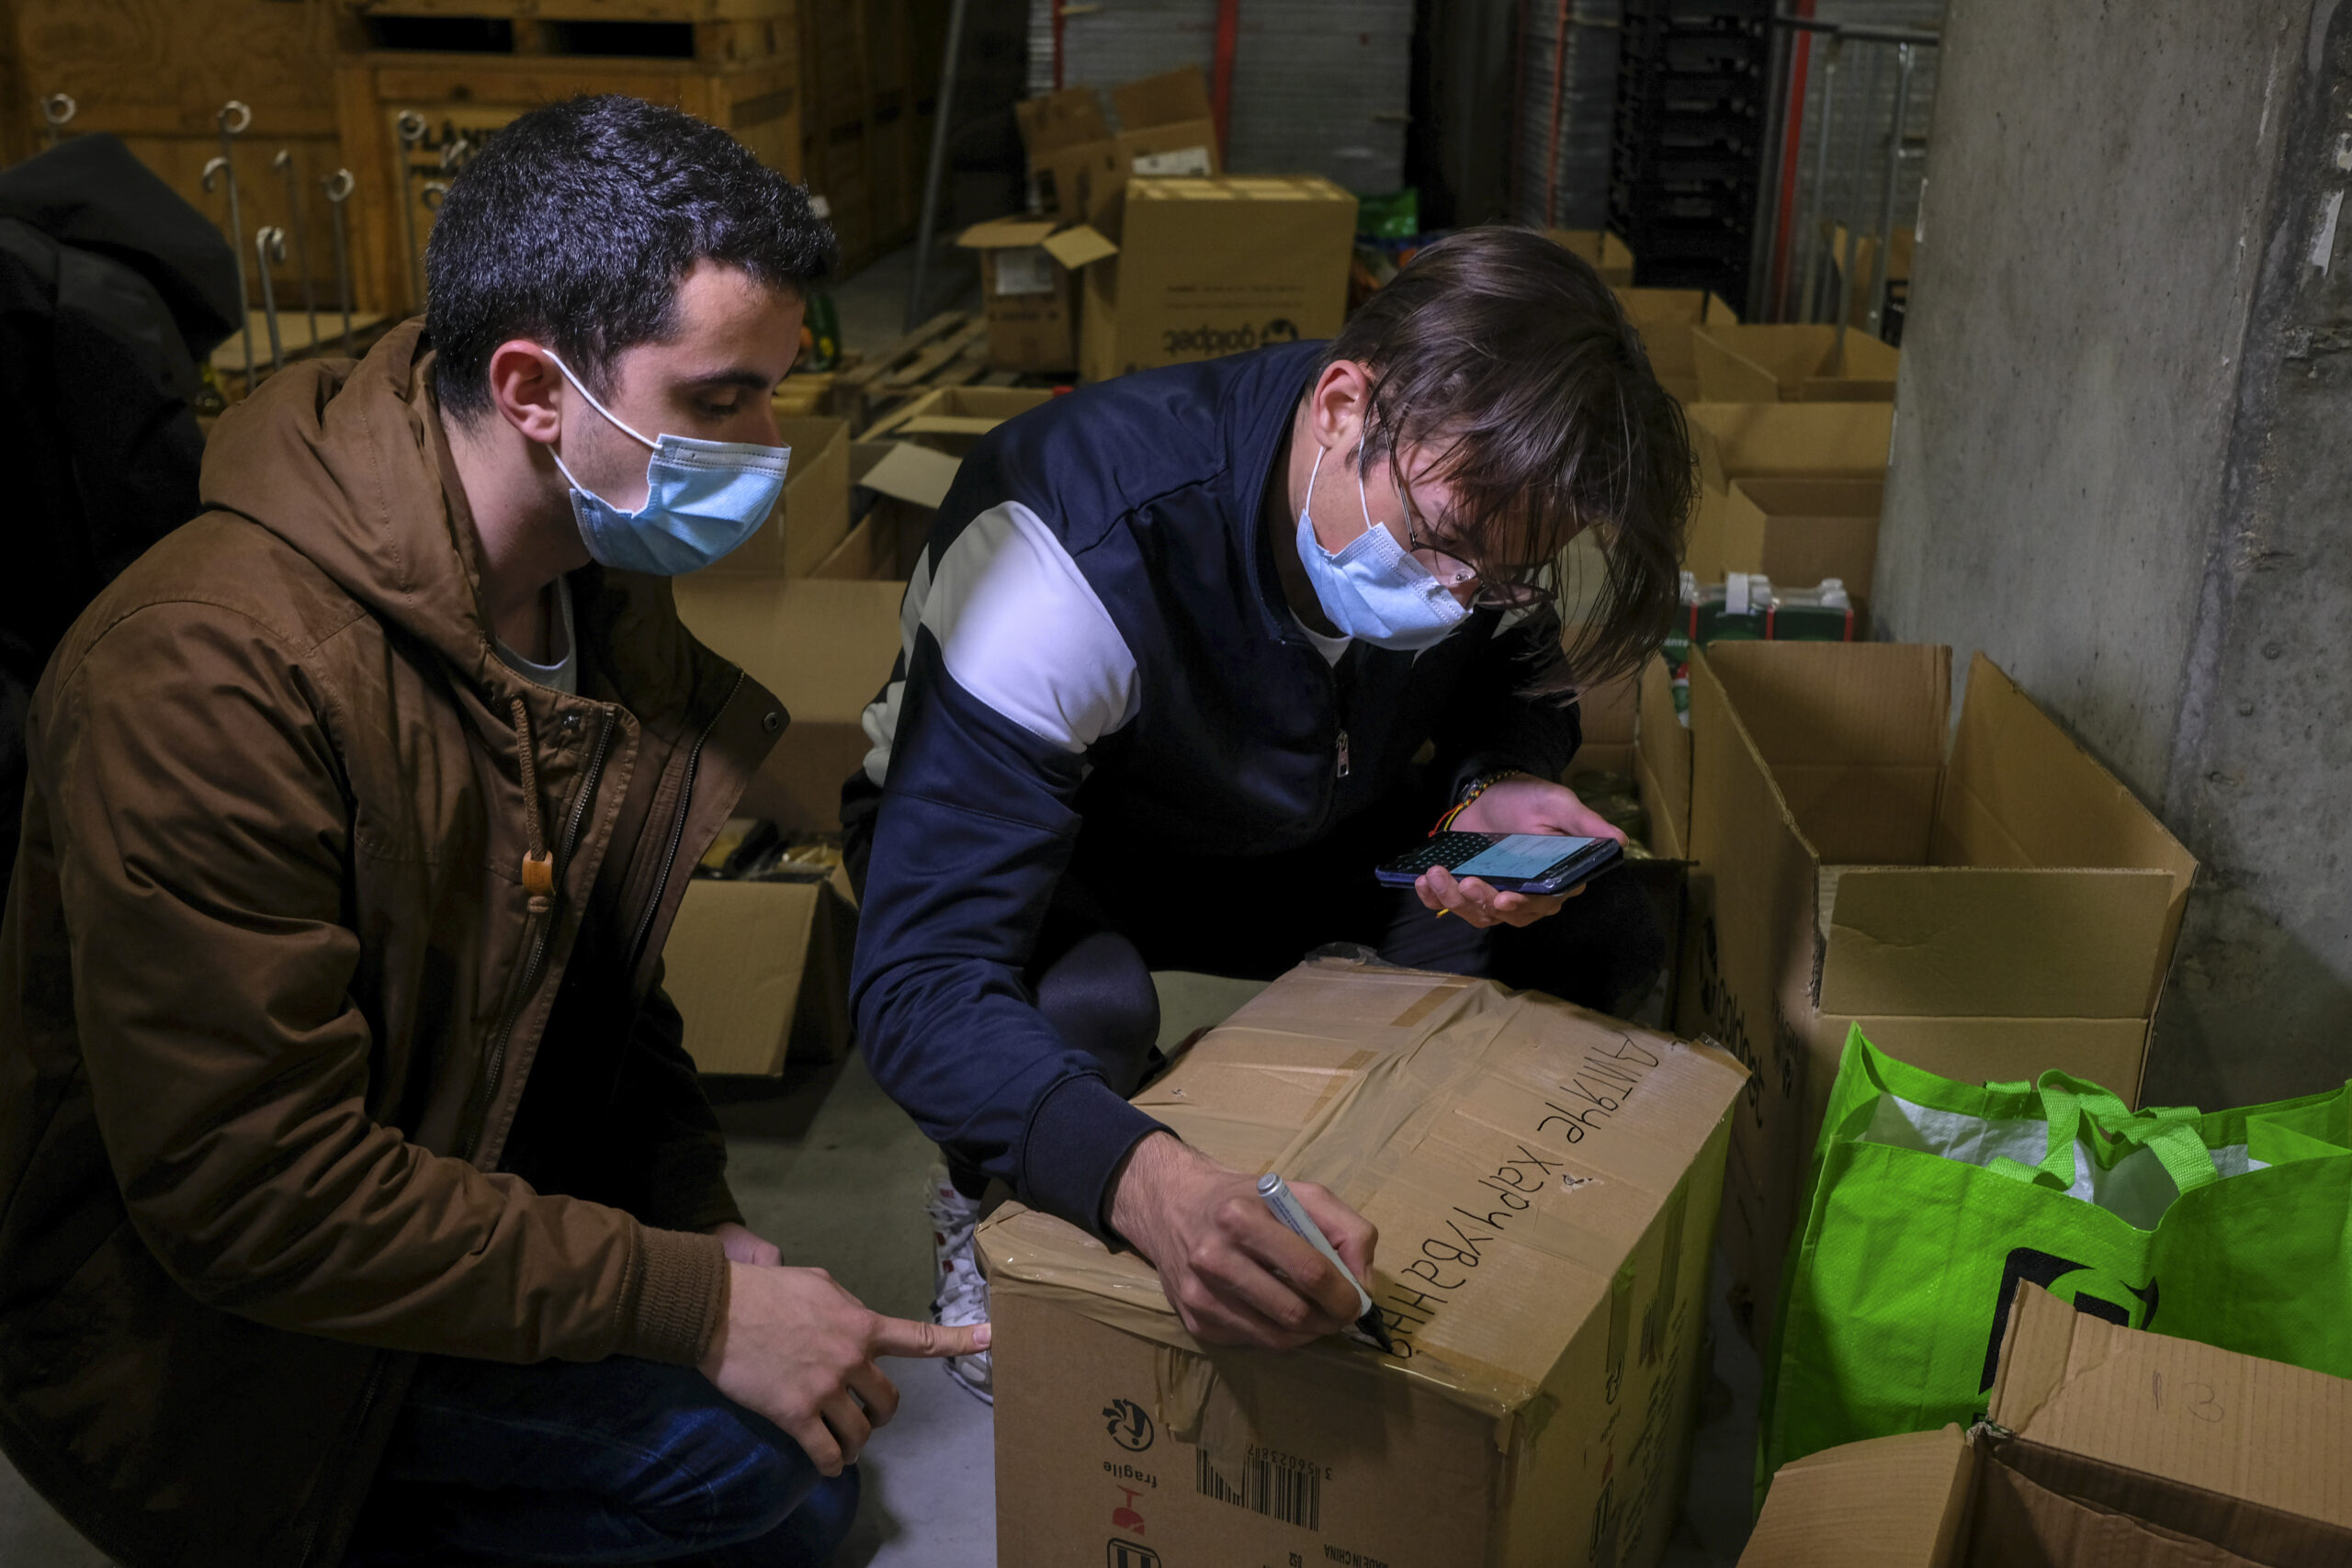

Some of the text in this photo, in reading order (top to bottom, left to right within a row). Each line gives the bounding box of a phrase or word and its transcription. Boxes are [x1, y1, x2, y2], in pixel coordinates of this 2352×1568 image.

[1103, 1461, 1158, 1488] fragile
[1324, 1543, 1351, 1565] CHINA
[1352, 1553, 1363, 1567] IN
